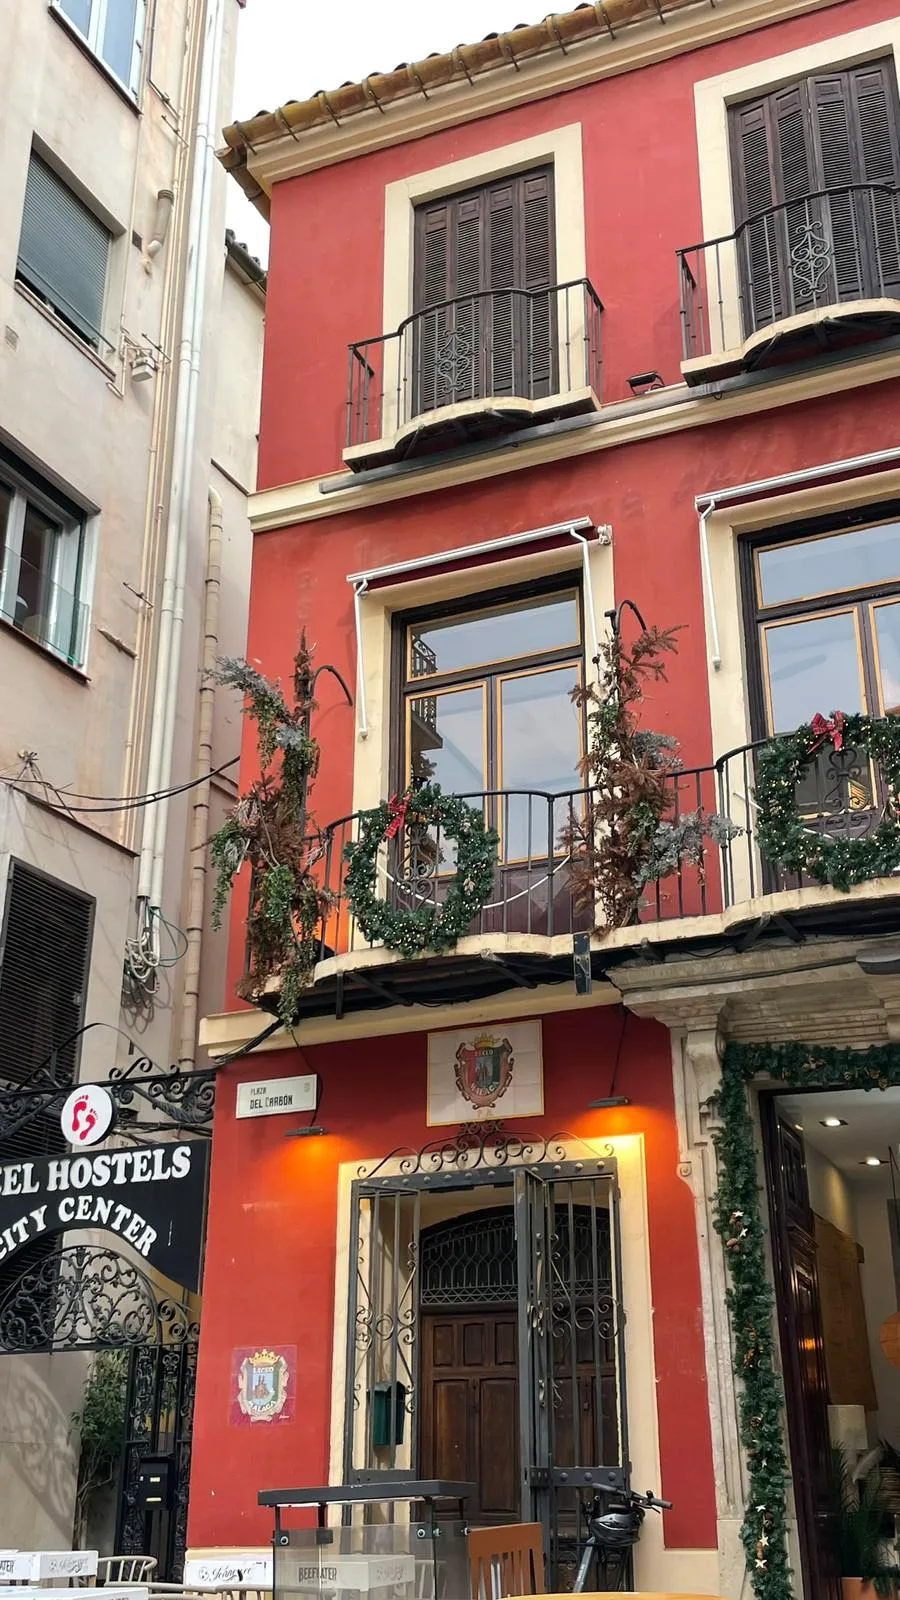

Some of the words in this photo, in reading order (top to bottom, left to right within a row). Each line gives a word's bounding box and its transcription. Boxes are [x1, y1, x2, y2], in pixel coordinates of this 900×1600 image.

[250, 1087, 267, 1096] PLAZA
[250, 1099, 263, 1110] DEL
[265, 1094, 293, 1108] CARBÓN
[0, 1162, 40, 1197] EL
[46, 1145, 192, 1192] HOSTELS
[58, 1195, 158, 1257] CENTER
